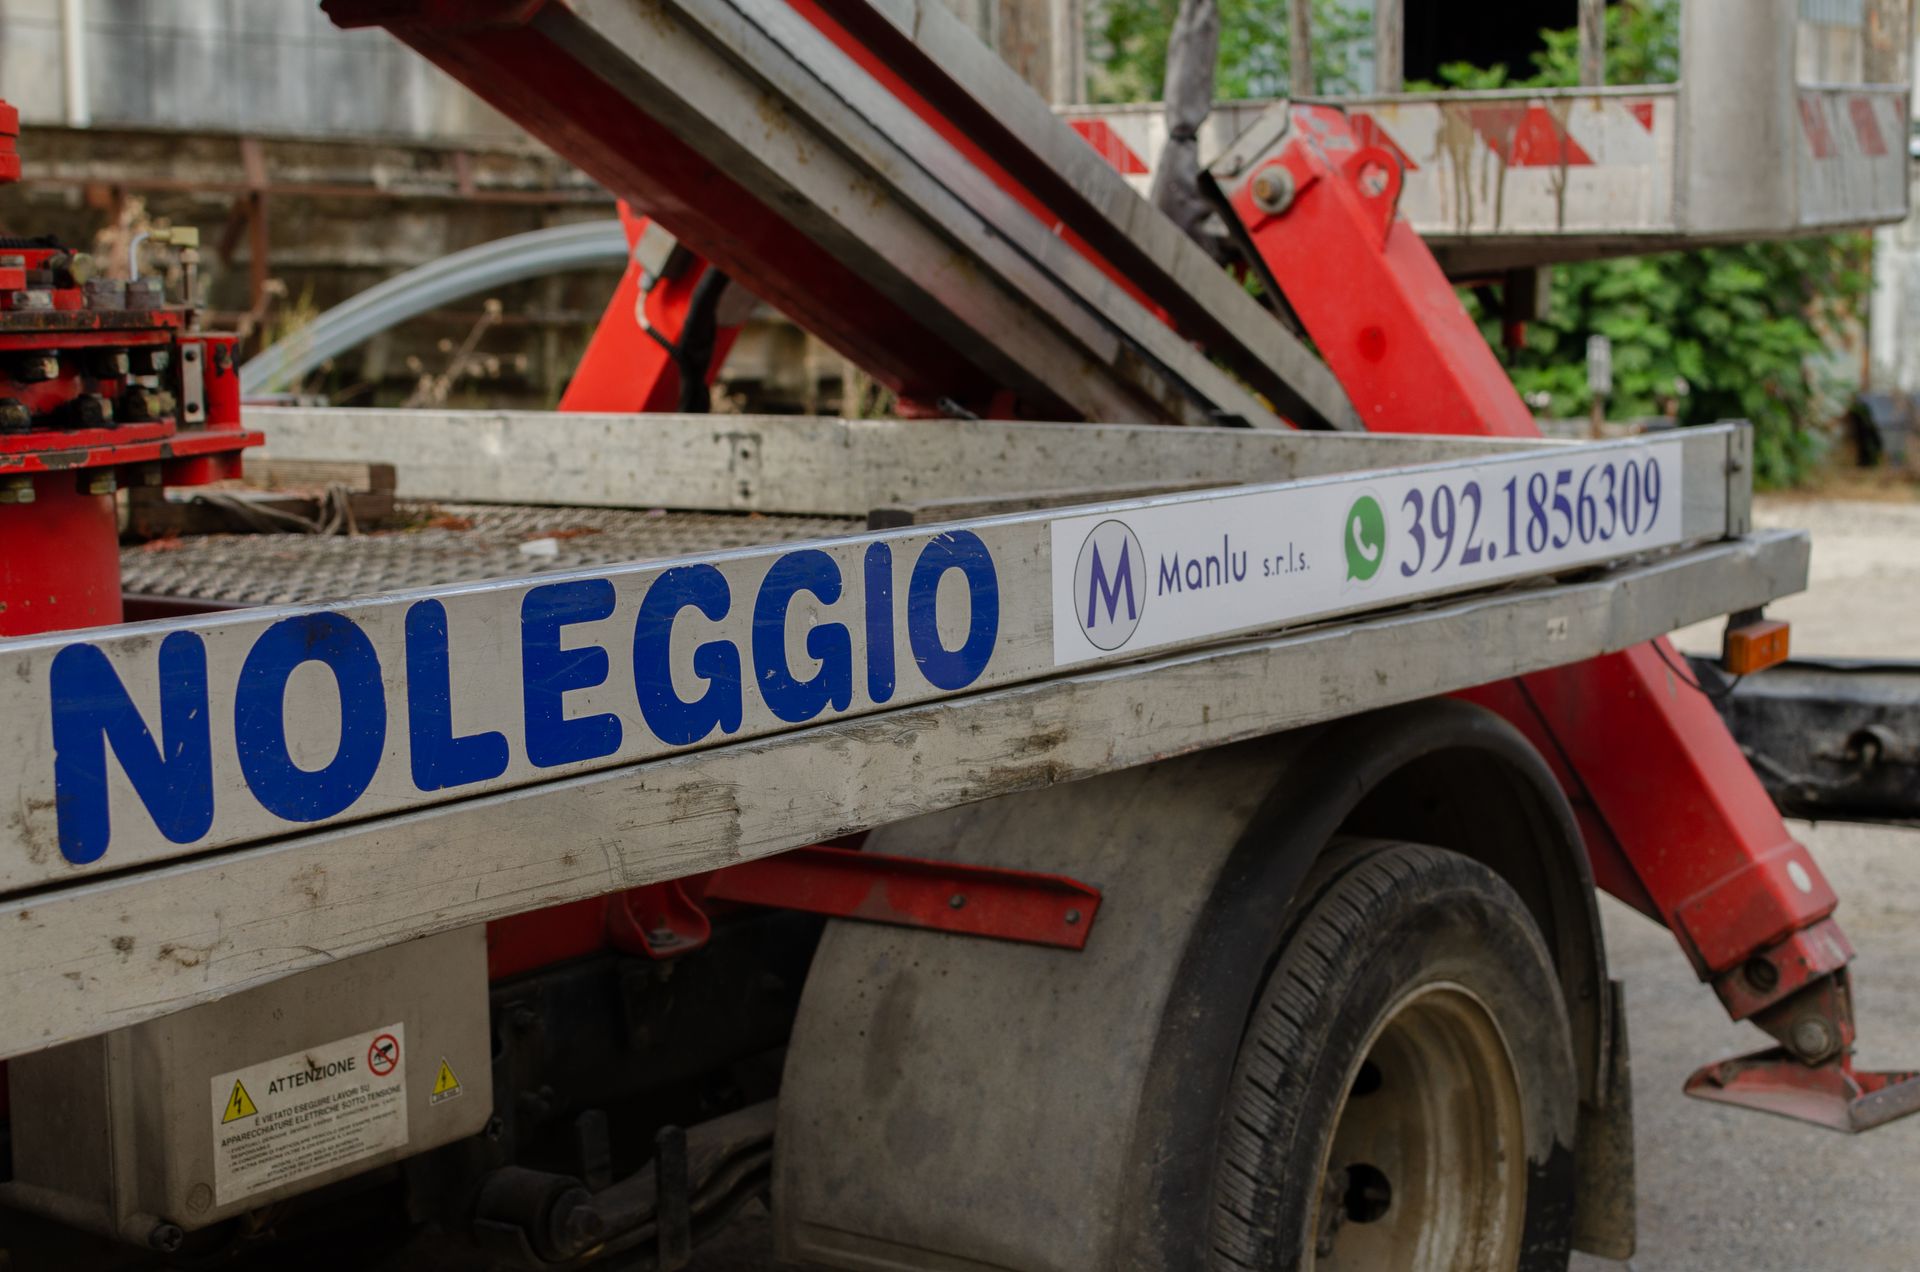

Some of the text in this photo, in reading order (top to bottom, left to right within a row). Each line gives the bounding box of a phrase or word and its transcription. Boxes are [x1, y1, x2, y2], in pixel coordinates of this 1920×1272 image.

[1401, 459, 1662, 577] 392.1856309
[1087, 538, 1137, 629] M
[1157, 534, 1311, 596] Manlu s.r.l.s.
[50, 530, 999, 864] NOLEGGIO
[262, 1107, 292, 1124] VIETATO
[294, 1095, 330, 1114] ESEGUIRE
[332, 1087, 359, 1102] LAVORI
[360, 1083, 370, 1094] SU
[267, 1057, 356, 1095] ATTENZIONE
[221, 1084, 401, 1147] APPARECCHIATURE ELETTRICHE SOTTO TENSIONE
